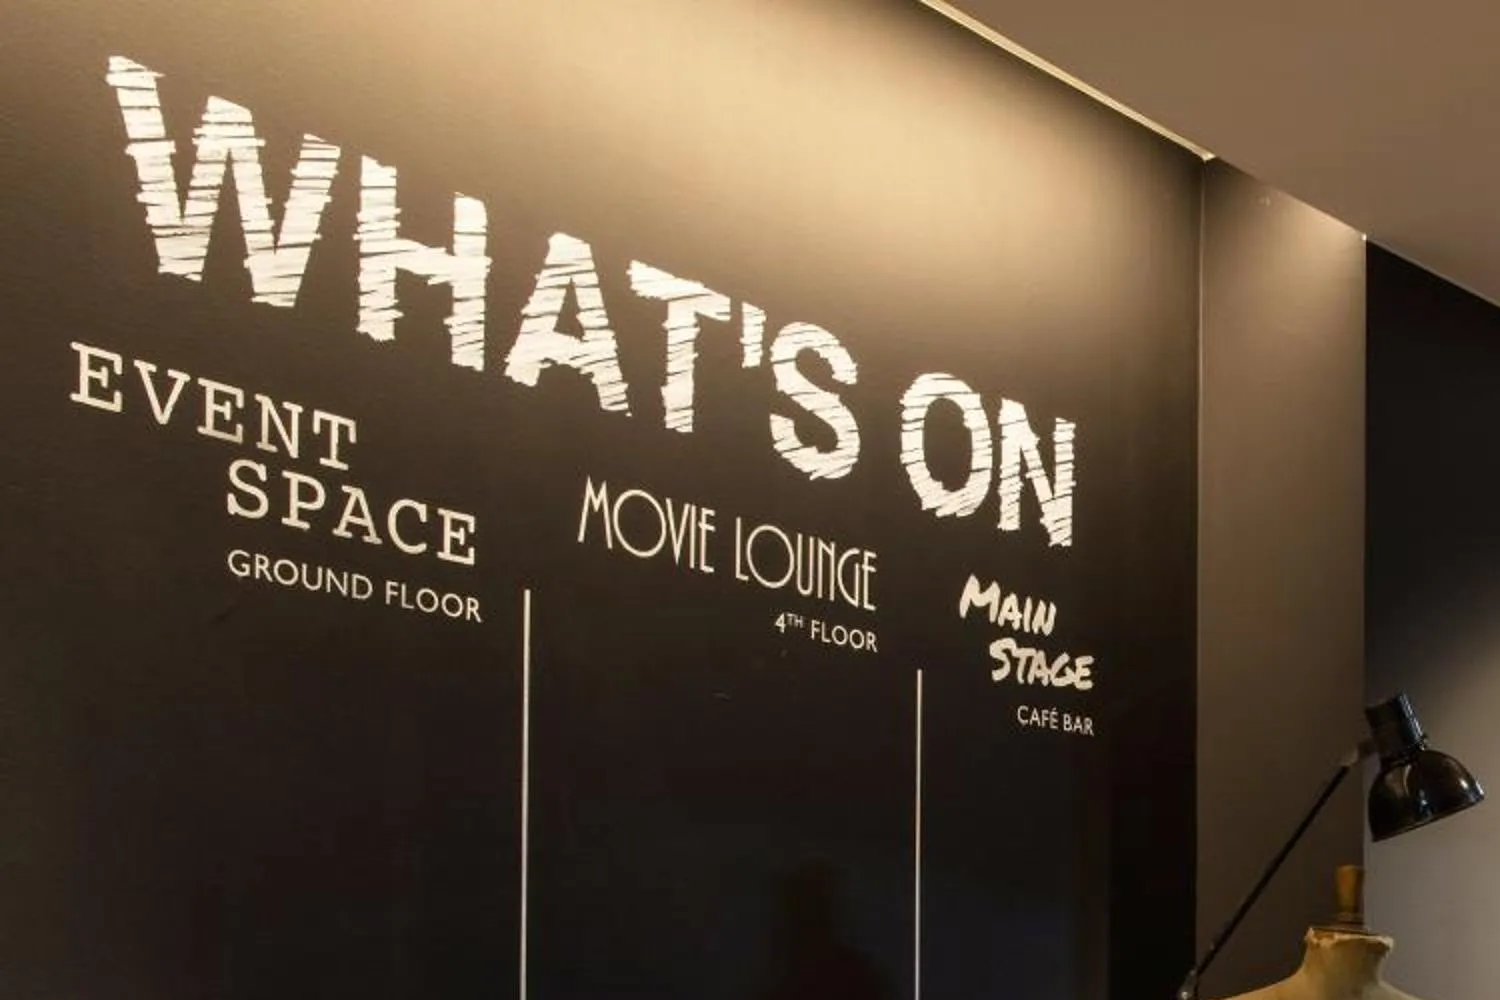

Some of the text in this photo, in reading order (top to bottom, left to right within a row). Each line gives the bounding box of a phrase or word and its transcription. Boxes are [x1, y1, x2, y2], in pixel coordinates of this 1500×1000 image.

[105, 55, 1077, 547] WHAT'S ON
[70, 341, 357, 471] EVENT
[227, 459, 476, 566] SPACE
[577, 476, 877, 611] MOVIE LOUNGE
[227, 549, 482, 623] GROUND FLOOR
[959, 574, 1057, 636] MAIN
[774, 612, 878, 653] 4TH FLOOR
[989, 637, 1094, 690] STAGE
[1017, 705, 1094, 736] CAFÉ BAR
